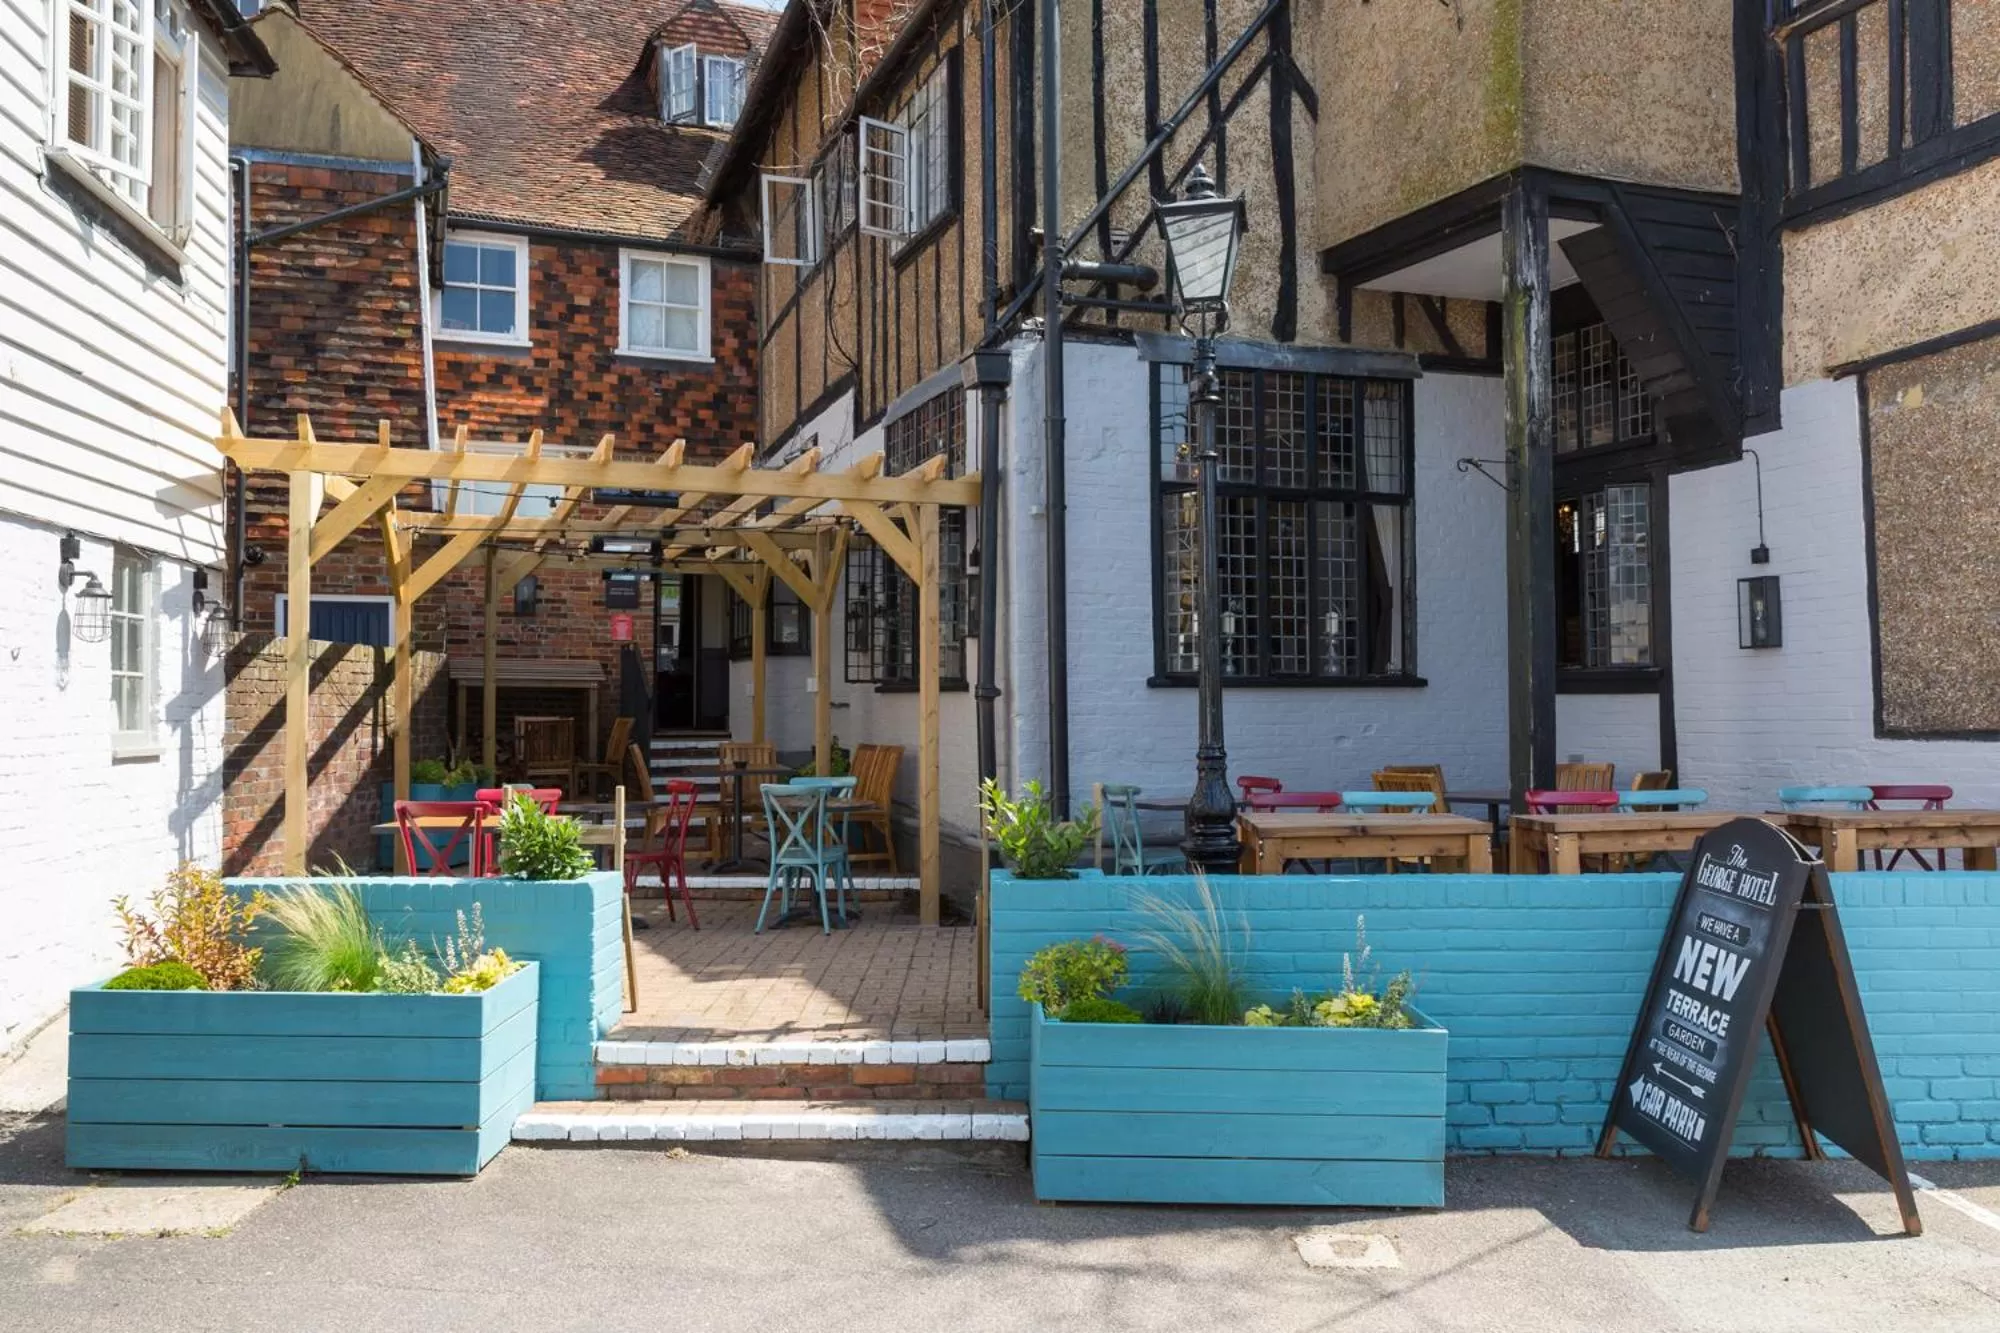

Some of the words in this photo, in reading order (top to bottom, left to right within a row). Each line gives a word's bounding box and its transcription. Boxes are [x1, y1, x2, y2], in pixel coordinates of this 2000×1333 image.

[1697, 852, 1738, 893] GEORGE
[1737, 871, 1779, 906] HOTEL
[1726, 844, 1748, 869] The
[1700, 915, 1715, 932] WE
[1713, 919, 1735, 940] HAVE
[1732, 927, 1741, 942] A
[1673, 935, 1751, 1002] NEW
[1666, 988, 1731, 1038] TERRACE
[1667, 1024, 1706, 1053] GARDEN
[1640, 1083, 1666, 1120] CAR
[1662, 1096, 1699, 1142] PARK
